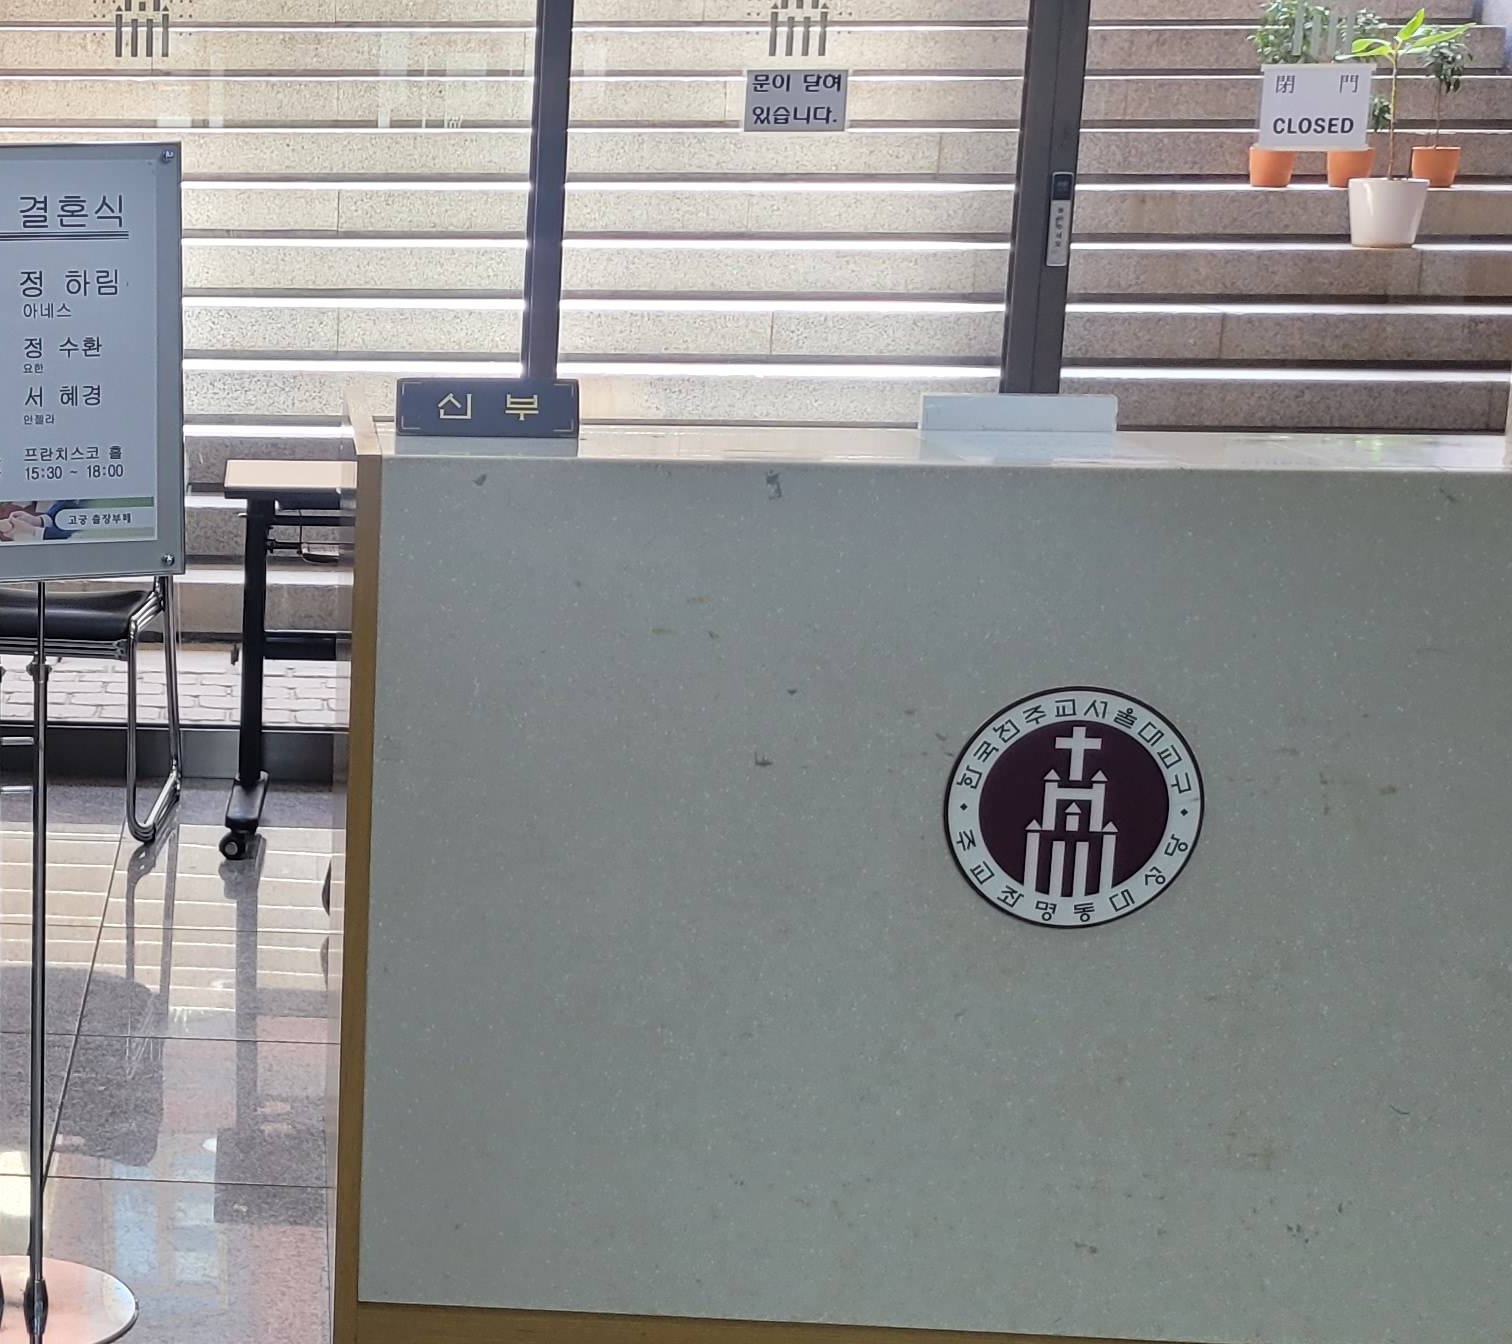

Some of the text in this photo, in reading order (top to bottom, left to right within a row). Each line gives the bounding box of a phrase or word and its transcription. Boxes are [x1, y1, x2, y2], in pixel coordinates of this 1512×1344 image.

[753, 74, 841, 92] 문이 닫여
[753, 107, 837, 124] 있습니다.
[1274, 118, 1353, 134] CLOSED
[20, 195, 122, 228] 결혼식
[20, 271, 42, 297] 정
[65, 269, 117, 296] 하림
[24, 303, 71, 318] 아네스
[24, 337, 102, 358] 정 수환
[24, 364, 43, 373] 요한
[25, 385, 100, 407] 서 혜경
[24, 447, 99, 461] 프란치스코
[110, 446, 121, 459] 홀
[26, 466, 62, 480] 15:30
[87, 464, 123, 478] 18:00
